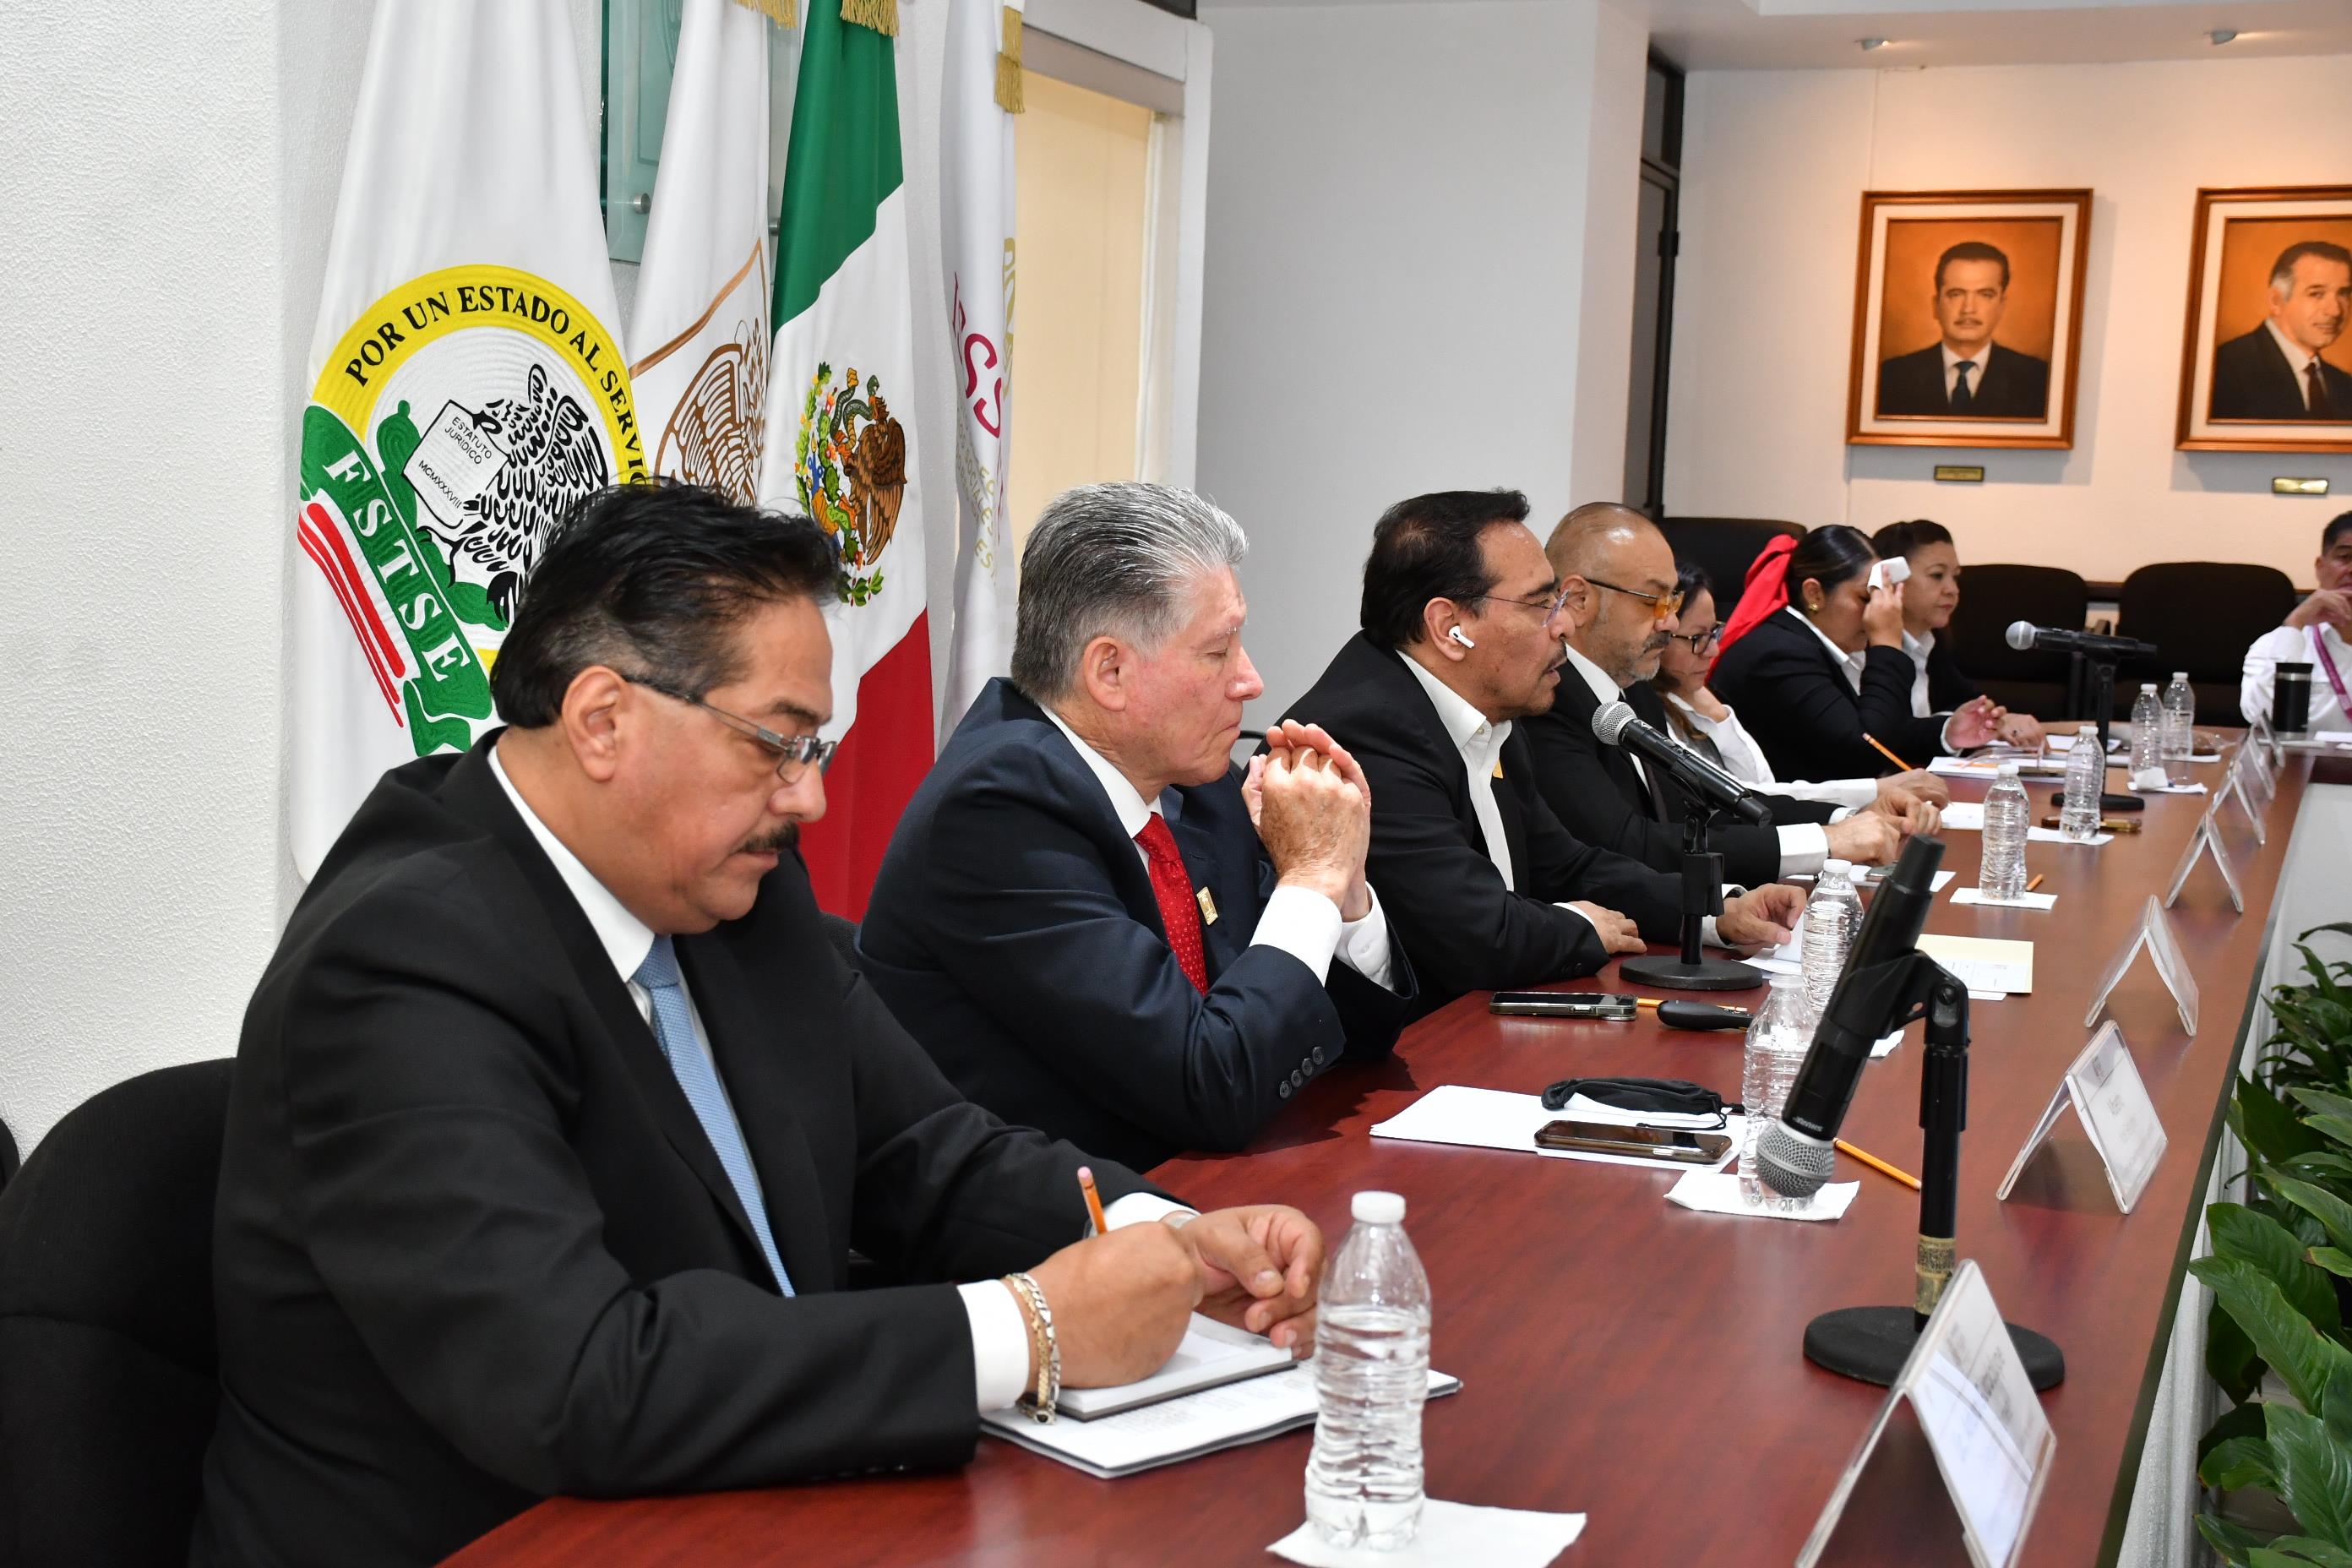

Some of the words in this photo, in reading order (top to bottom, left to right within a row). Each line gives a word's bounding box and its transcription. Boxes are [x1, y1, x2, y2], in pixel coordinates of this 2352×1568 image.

[345, 322, 406, 387] POR
[401, 291, 450, 330] UN
[456, 285, 570, 335] ESTADO
[569, 329, 601, 372] AL
[444, 427, 482, 465] JURIDICO
[452, 416, 492, 459] ESTATUTO
[418, 460, 463, 509] MCMXXXVIII
[323, 449, 471, 682] FSTSE
